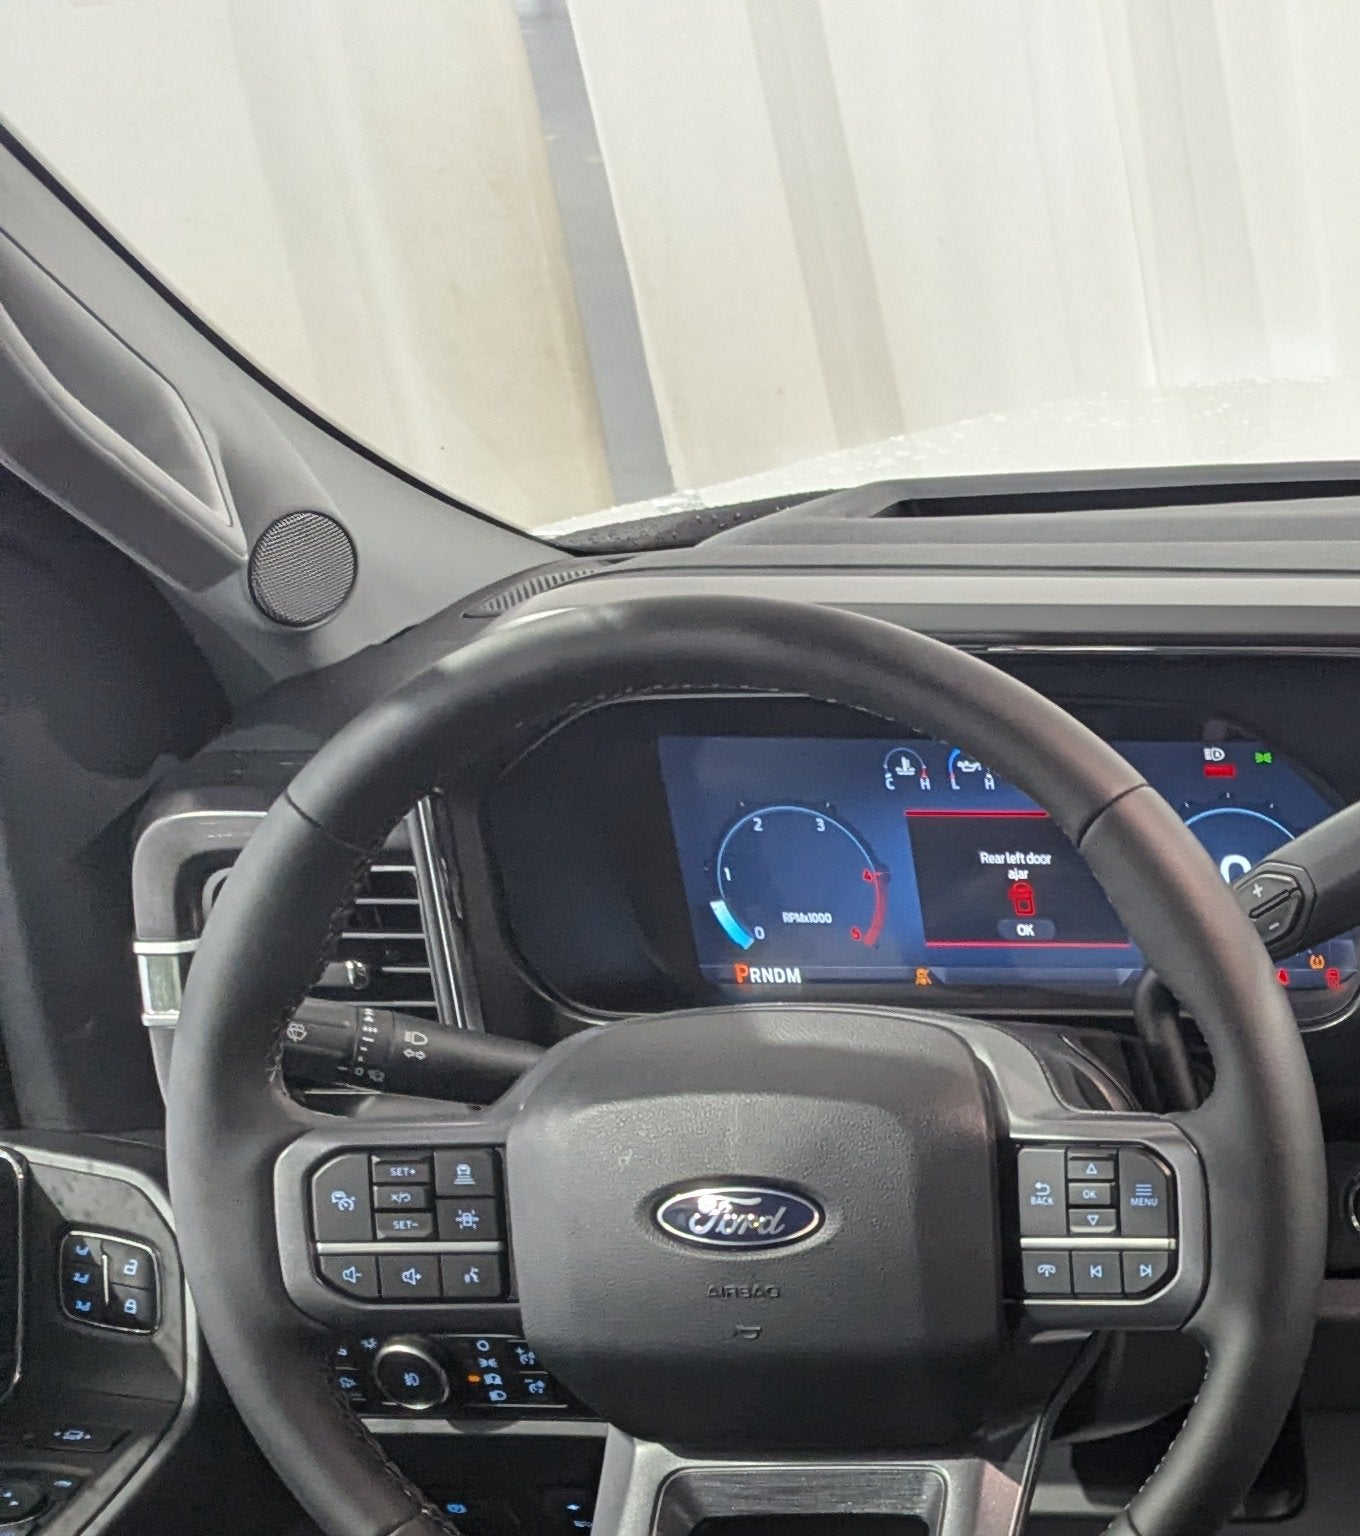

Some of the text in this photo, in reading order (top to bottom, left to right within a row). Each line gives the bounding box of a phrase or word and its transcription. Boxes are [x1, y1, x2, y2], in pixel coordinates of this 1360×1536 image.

[753, 818, 763, 832] 2
[816, 818, 826, 832] 3
[980, 851, 1051, 865] Rear left door
[1008, 868, 1029, 881] ajar
[754, 926, 766, 940] 0
[1016, 923, 1035, 936] OK
[734, 963, 802, 984] PRNDM
[390, 1166, 417, 1177] SET+
[1030, 1196, 1054, 1206] BACK
[1082, 1189, 1097, 1199] OK
[1130, 1197, 1159, 1207] MENU
[688, 1194, 787, 1235] Ford
[706, 1284, 782, 1299] AIRBAG
